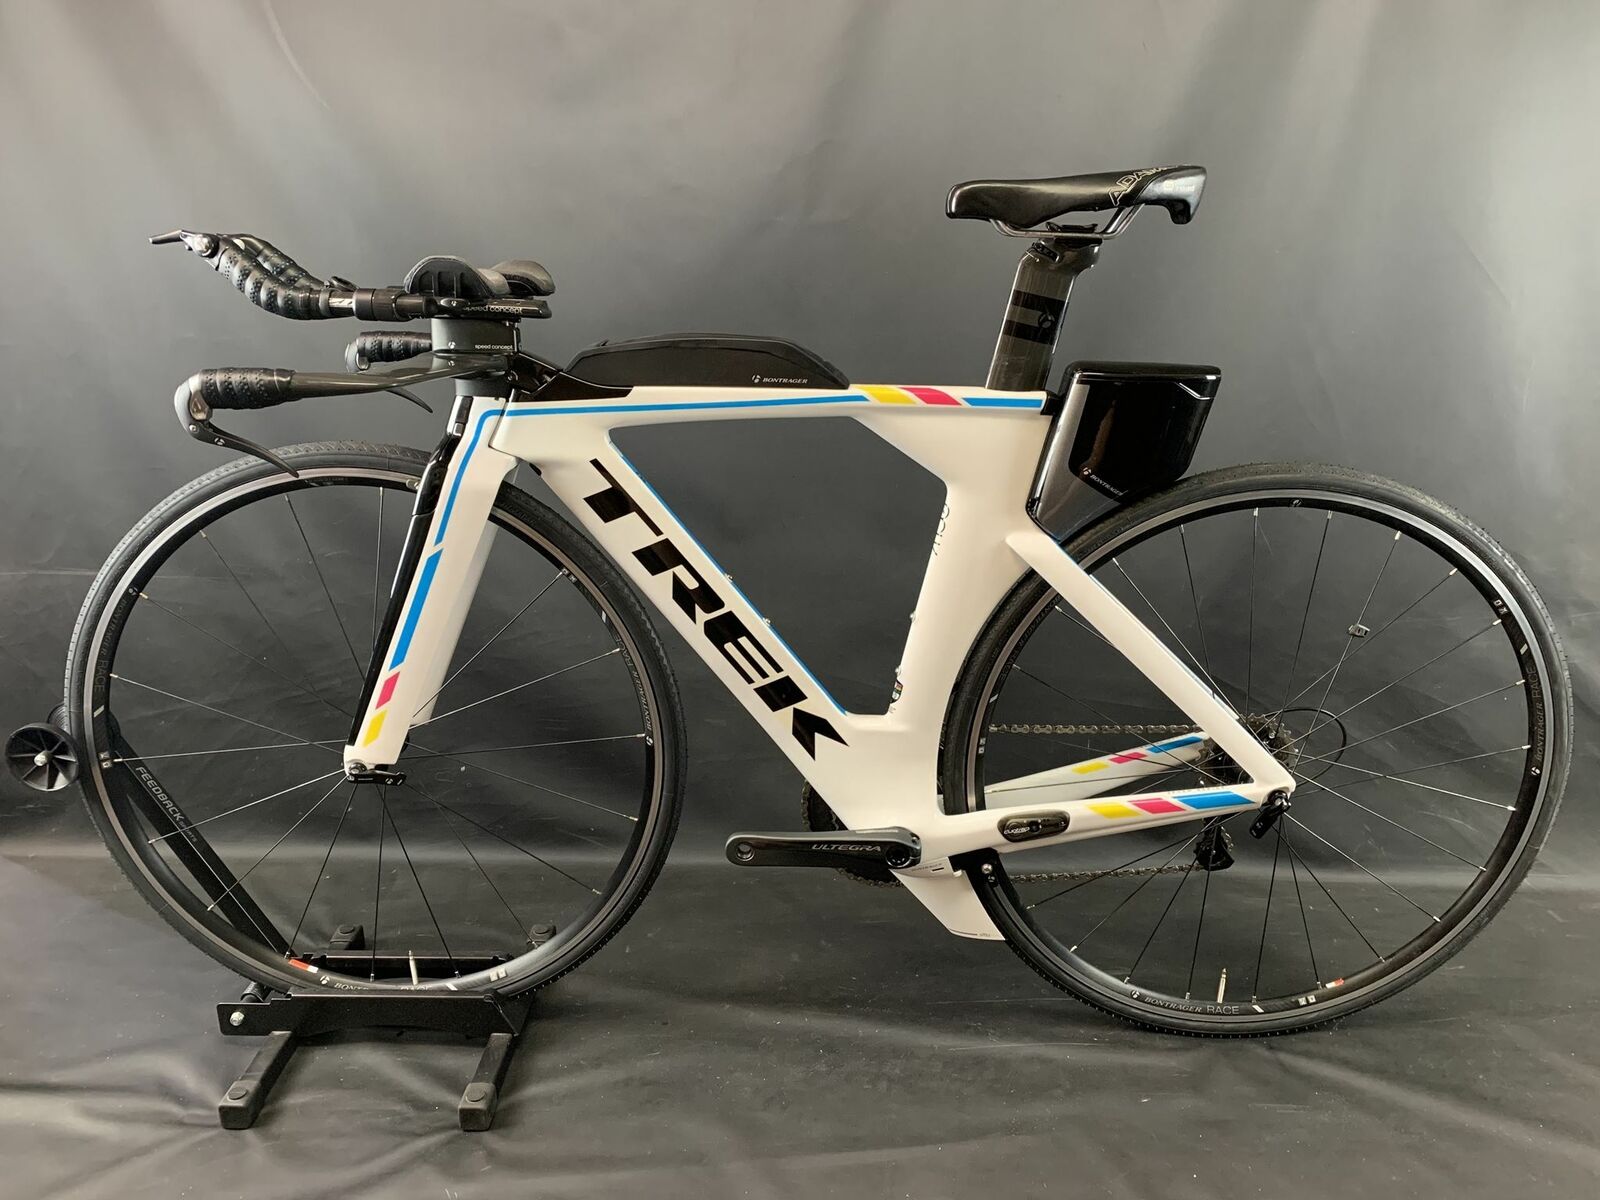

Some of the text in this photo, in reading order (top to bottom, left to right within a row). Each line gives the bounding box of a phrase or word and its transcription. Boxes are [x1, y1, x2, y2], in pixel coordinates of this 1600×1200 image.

[583, 458, 850, 761] TREK
[1526, 664, 1543, 699] RACE
[135, 766, 185, 821] FEEDBACK
[811, 843, 881, 852] ULTEGRA
[1144, 996, 1240, 1016] BONTRAGER RACE
